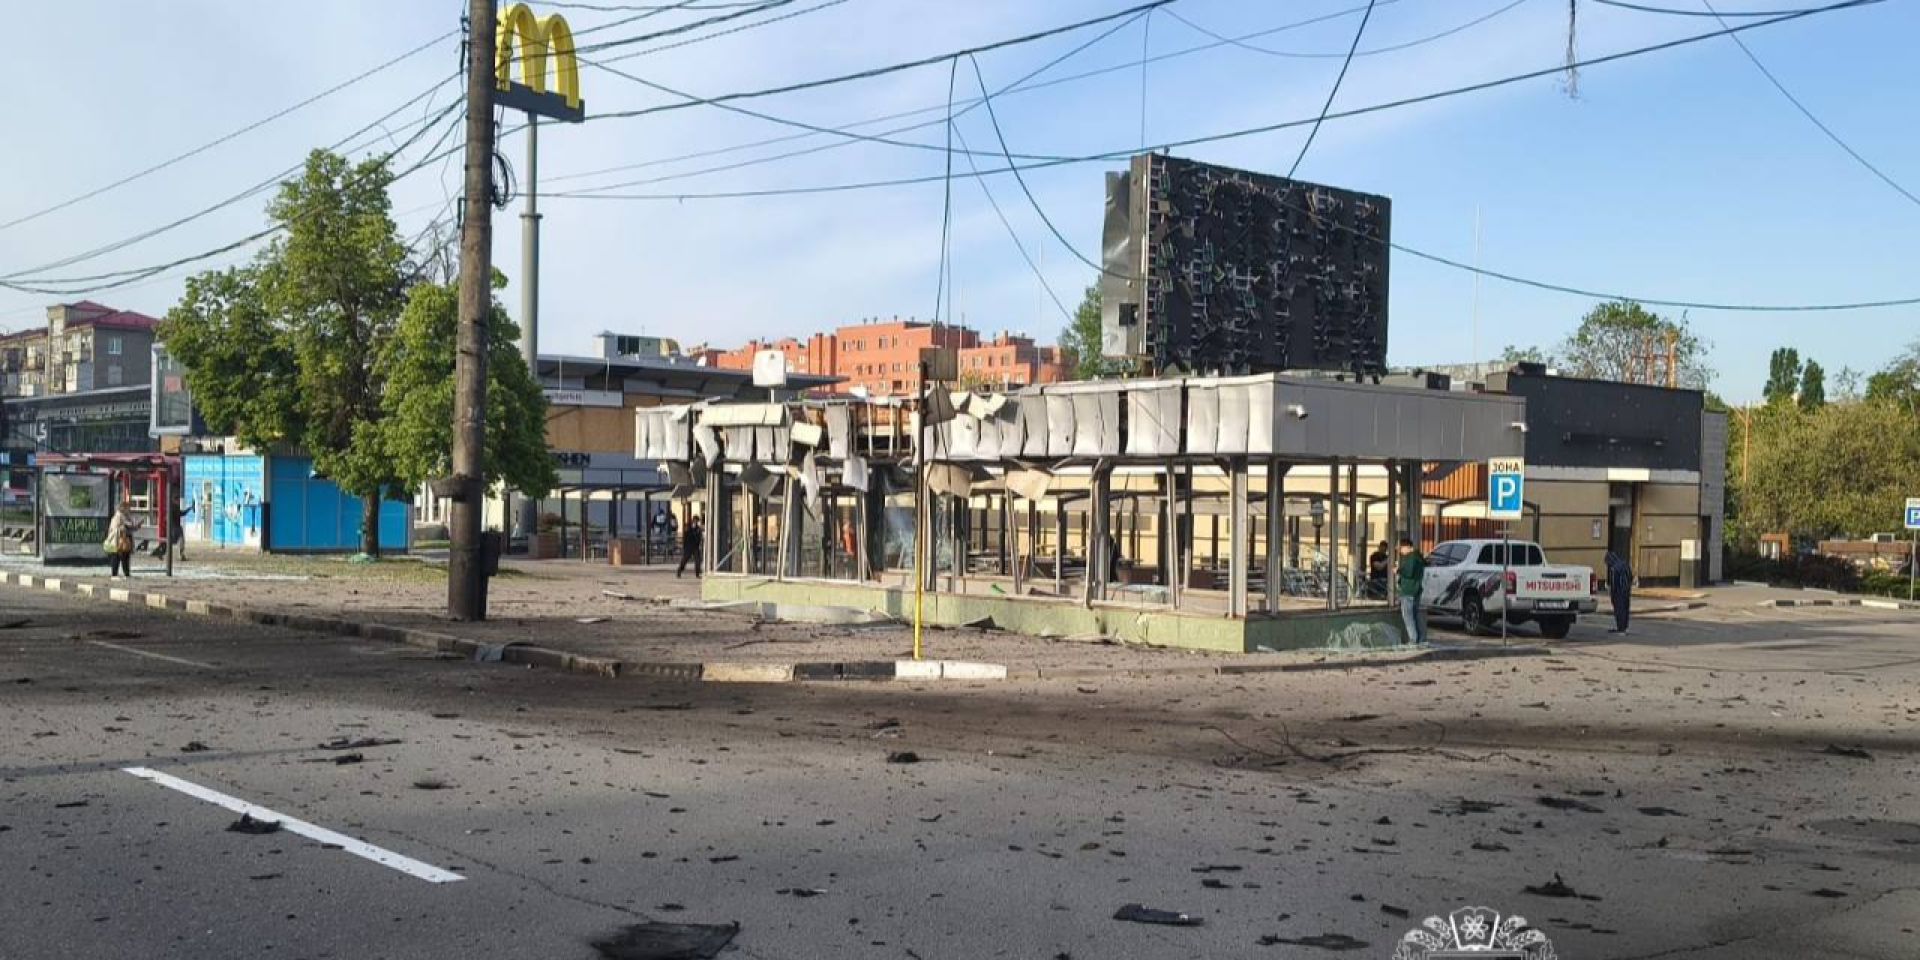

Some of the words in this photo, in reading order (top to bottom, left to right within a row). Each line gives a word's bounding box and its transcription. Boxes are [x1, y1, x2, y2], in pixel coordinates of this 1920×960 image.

[1493, 461, 1520, 472] ЗОНА
[1497, 477, 1516, 508] P
[1525, 581, 1581, 592] MITSUBISHI
